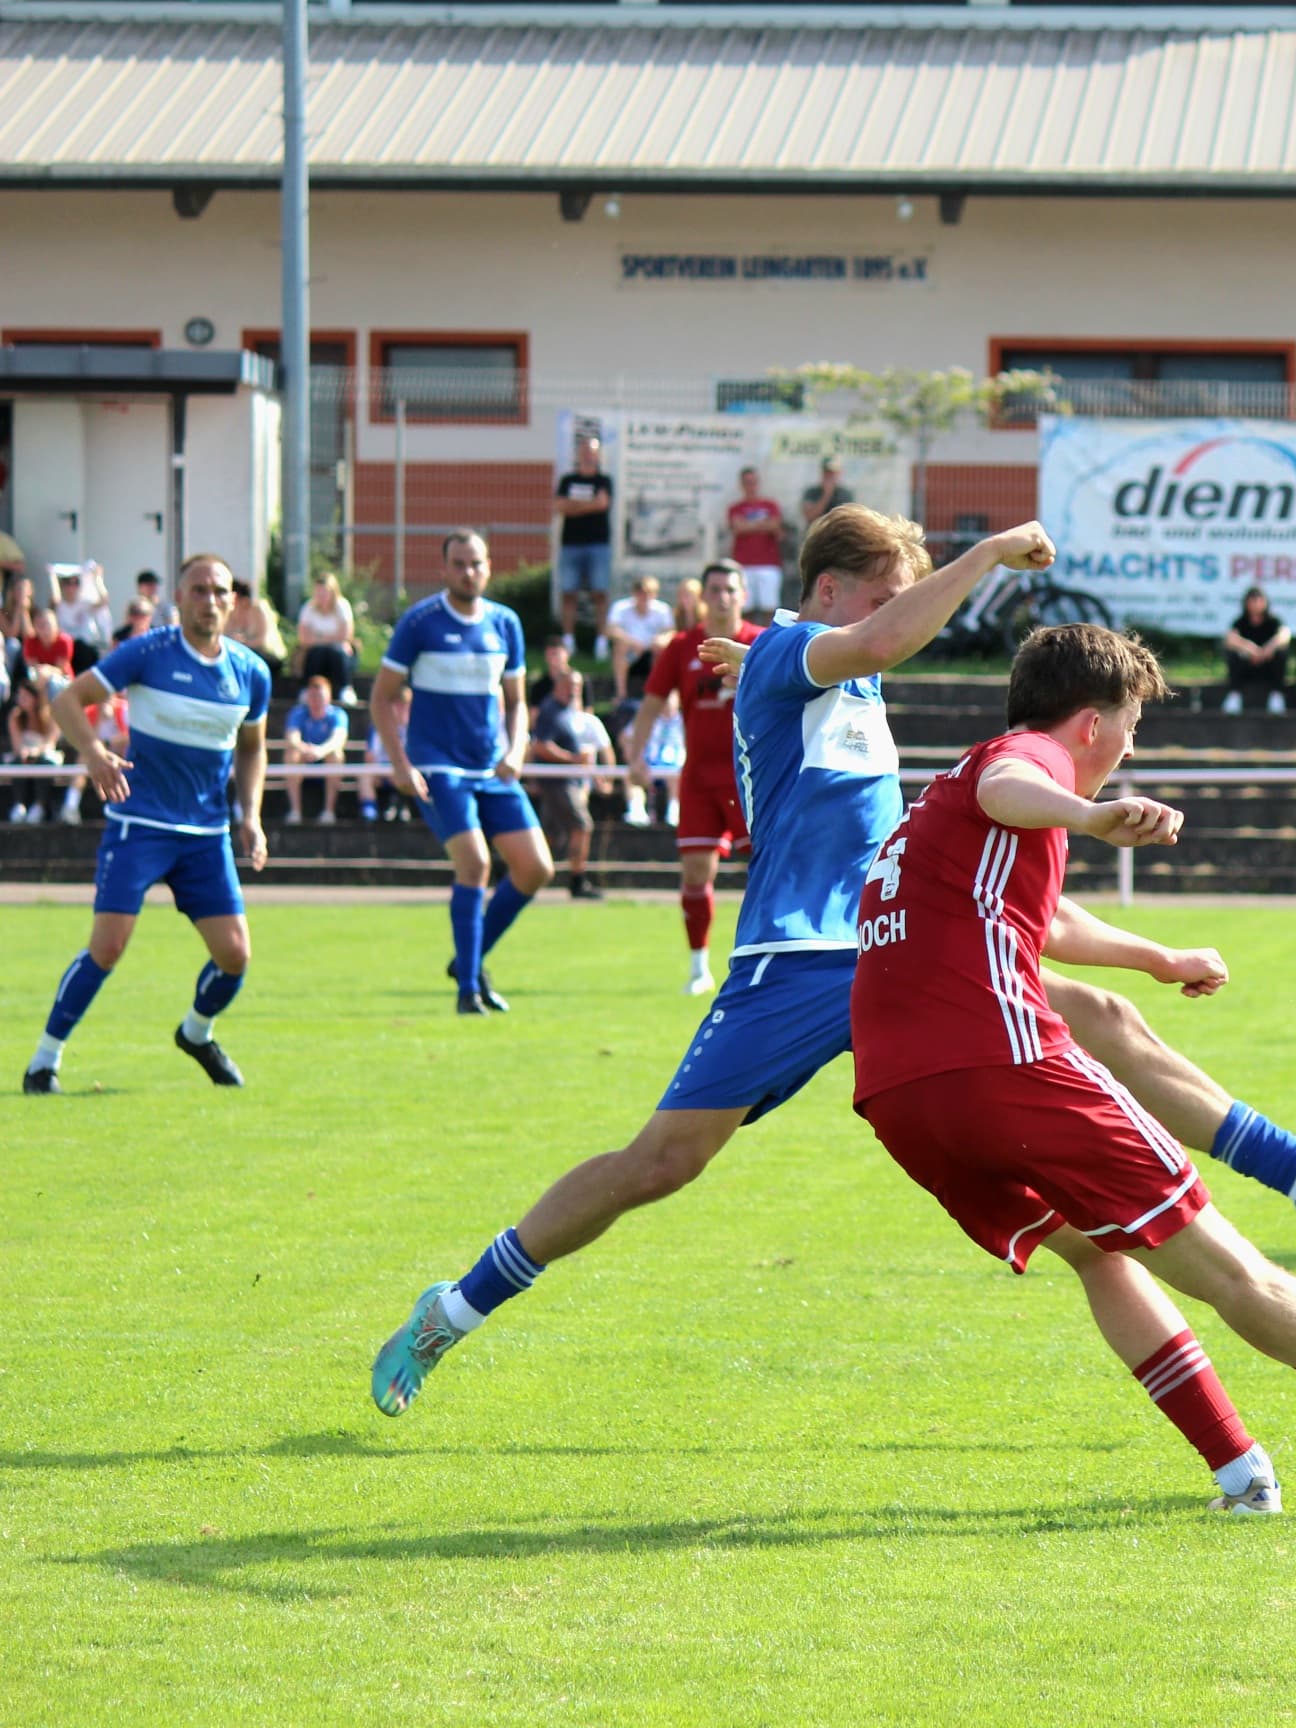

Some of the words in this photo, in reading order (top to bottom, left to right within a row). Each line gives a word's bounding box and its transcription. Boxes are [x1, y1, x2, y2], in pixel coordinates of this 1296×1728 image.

[621, 255, 737, 280] SPORTVEREIN
[1113, 466, 1296, 521] diem
[857, 908, 907, 957] OCH
